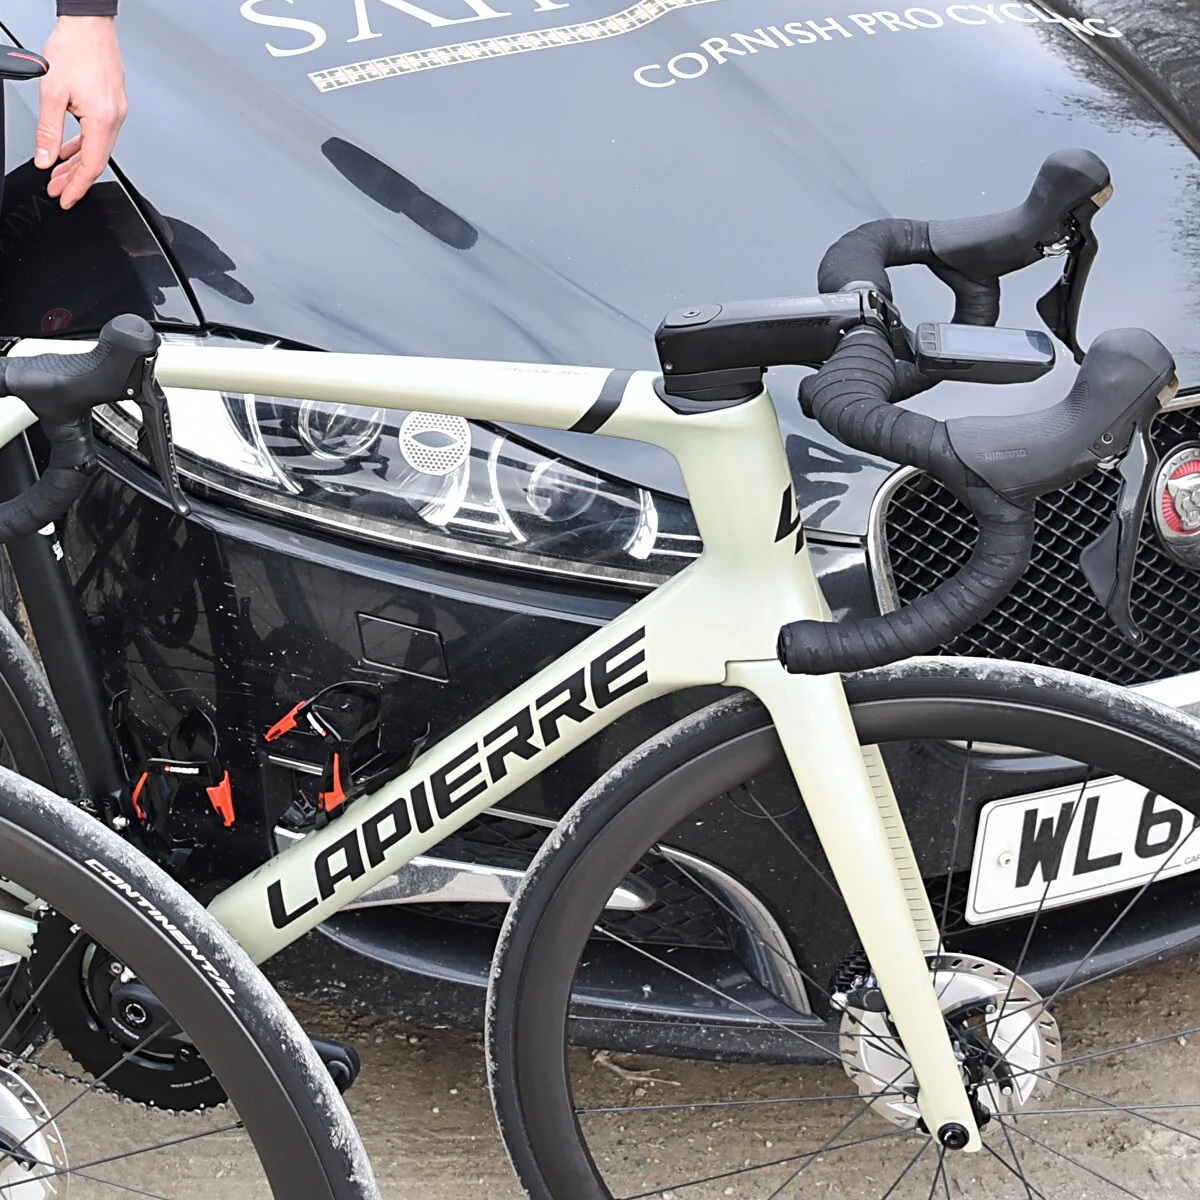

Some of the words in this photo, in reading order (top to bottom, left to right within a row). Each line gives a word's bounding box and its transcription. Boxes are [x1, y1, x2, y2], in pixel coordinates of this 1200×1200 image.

[633, 17, 852, 88] CORNISH
[848, 6, 943, 36] PRO
[266, 624, 649, 930] LAPIERRE
[1015, 789, 1200, 889] WL6
[84, 858, 236, 1004] CONTINENTAL
